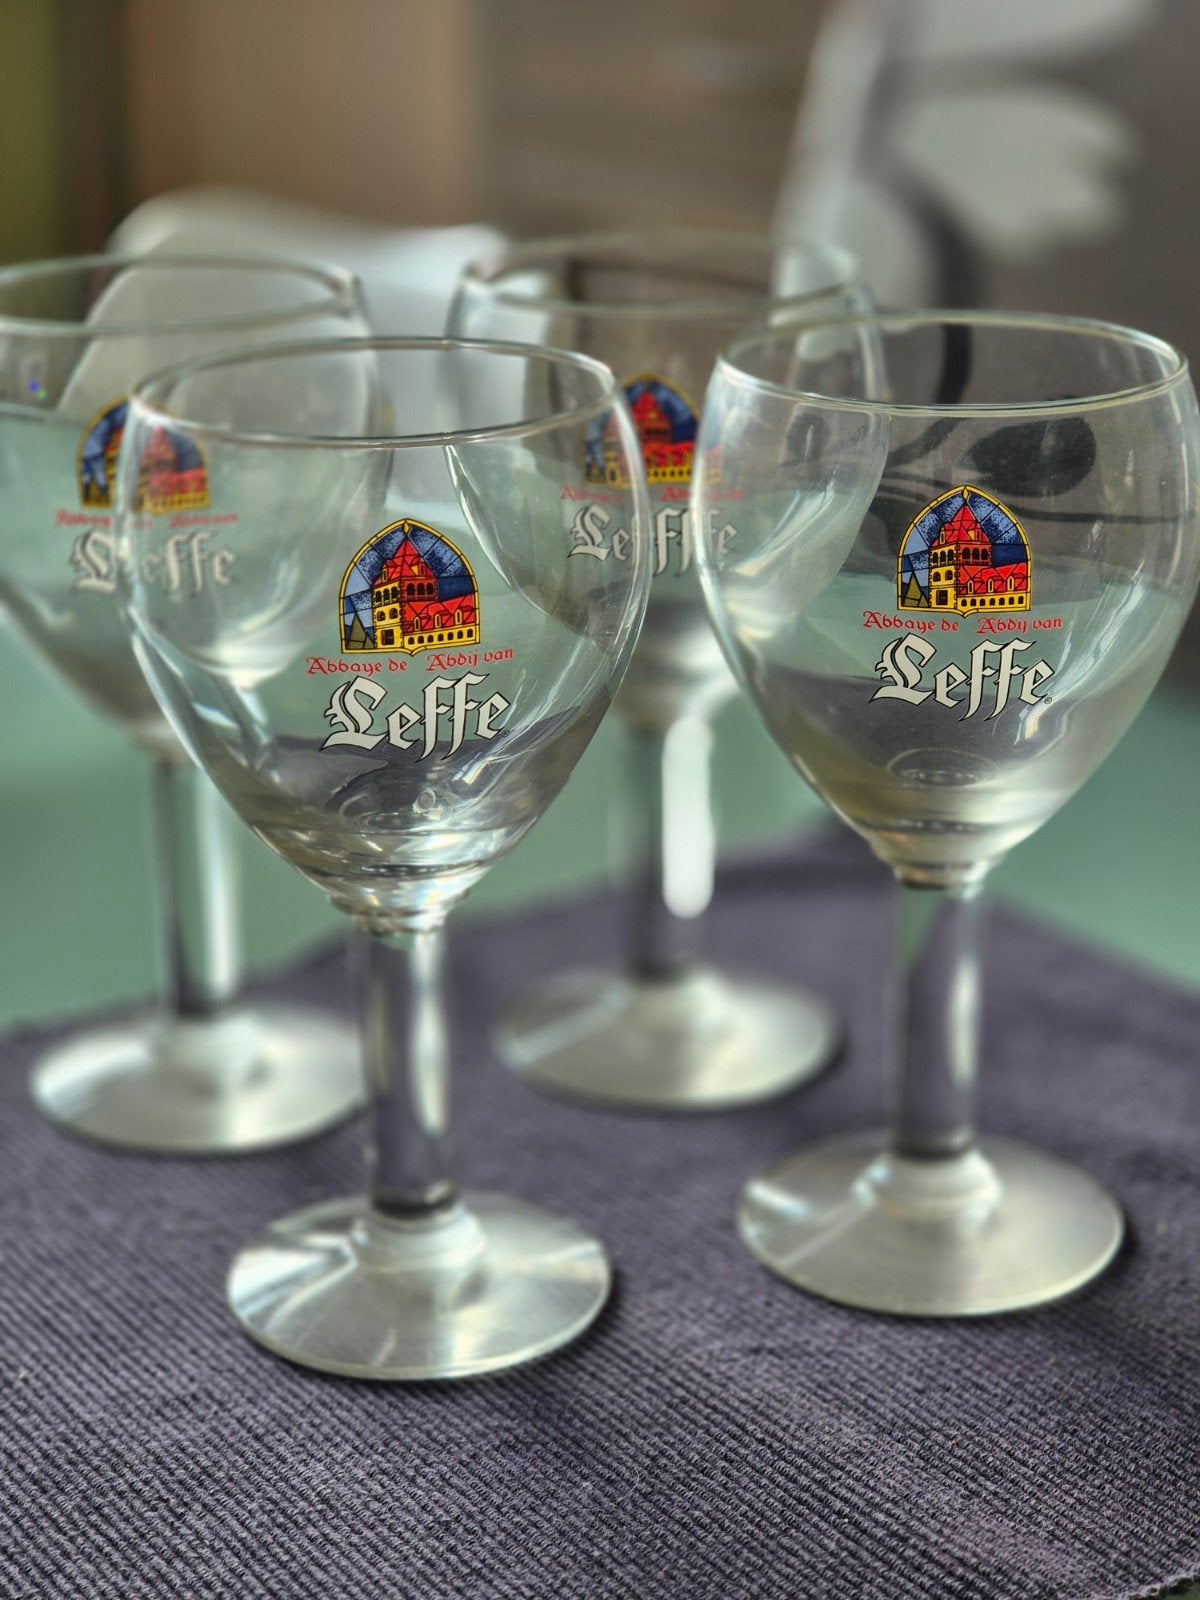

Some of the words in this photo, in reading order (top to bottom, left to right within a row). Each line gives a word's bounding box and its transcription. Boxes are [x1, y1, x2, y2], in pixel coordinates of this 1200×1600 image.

[862, 610, 934, 634] Abbaye
[941, 617, 959, 633] de
[976, 616, 1027, 634] Abdij
[1032, 616, 1063, 630] van
[306, 656, 382, 677] Abbaye
[388, 657, 408, 672] de
[426, 650, 479, 672] Abdij
[483, 648, 515, 664] van
[868, 632, 1055, 721] Leffe
[320, 671, 511, 763] Leffe
